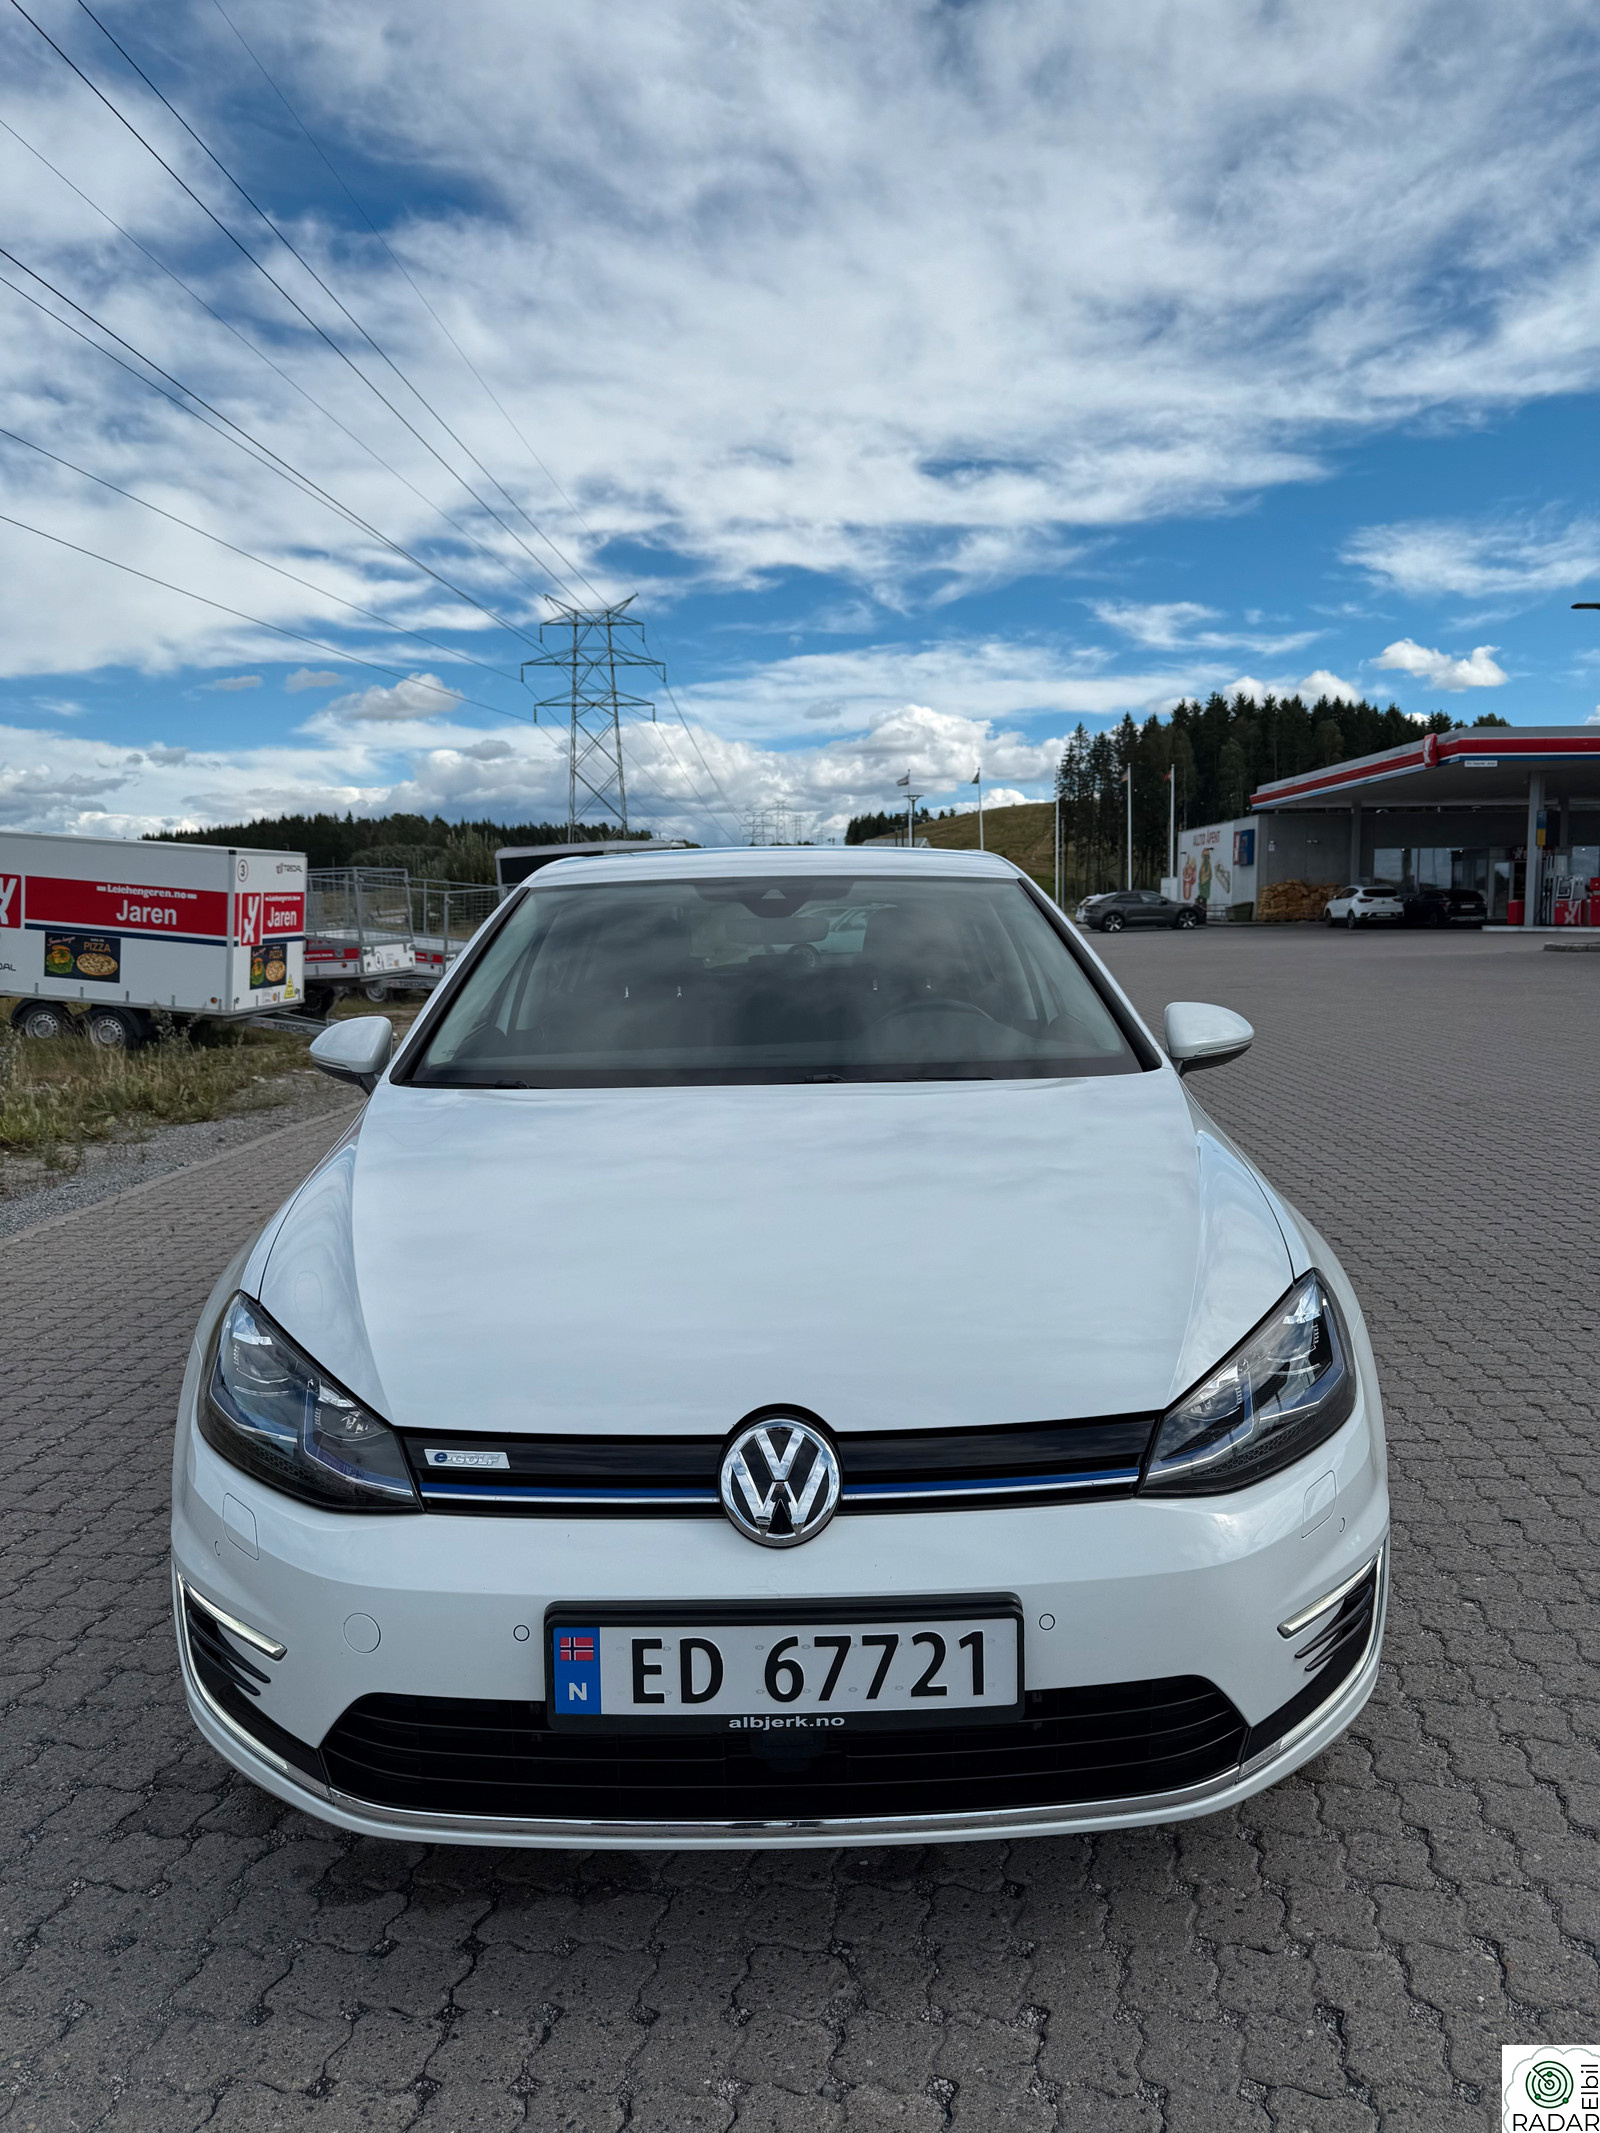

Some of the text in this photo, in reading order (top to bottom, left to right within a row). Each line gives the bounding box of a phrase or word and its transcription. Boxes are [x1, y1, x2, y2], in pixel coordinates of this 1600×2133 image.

[240, 864, 246, 877] 3
[116, 899, 177, 926] Jaren
[267, 906, 297, 928] Jaren
[83, 941, 111, 953] PIZZA
[631, 1630, 985, 1704] ED 67721
[568, 1682, 588, 1701] N
[728, 1715, 846, 1731] albjerk.no
